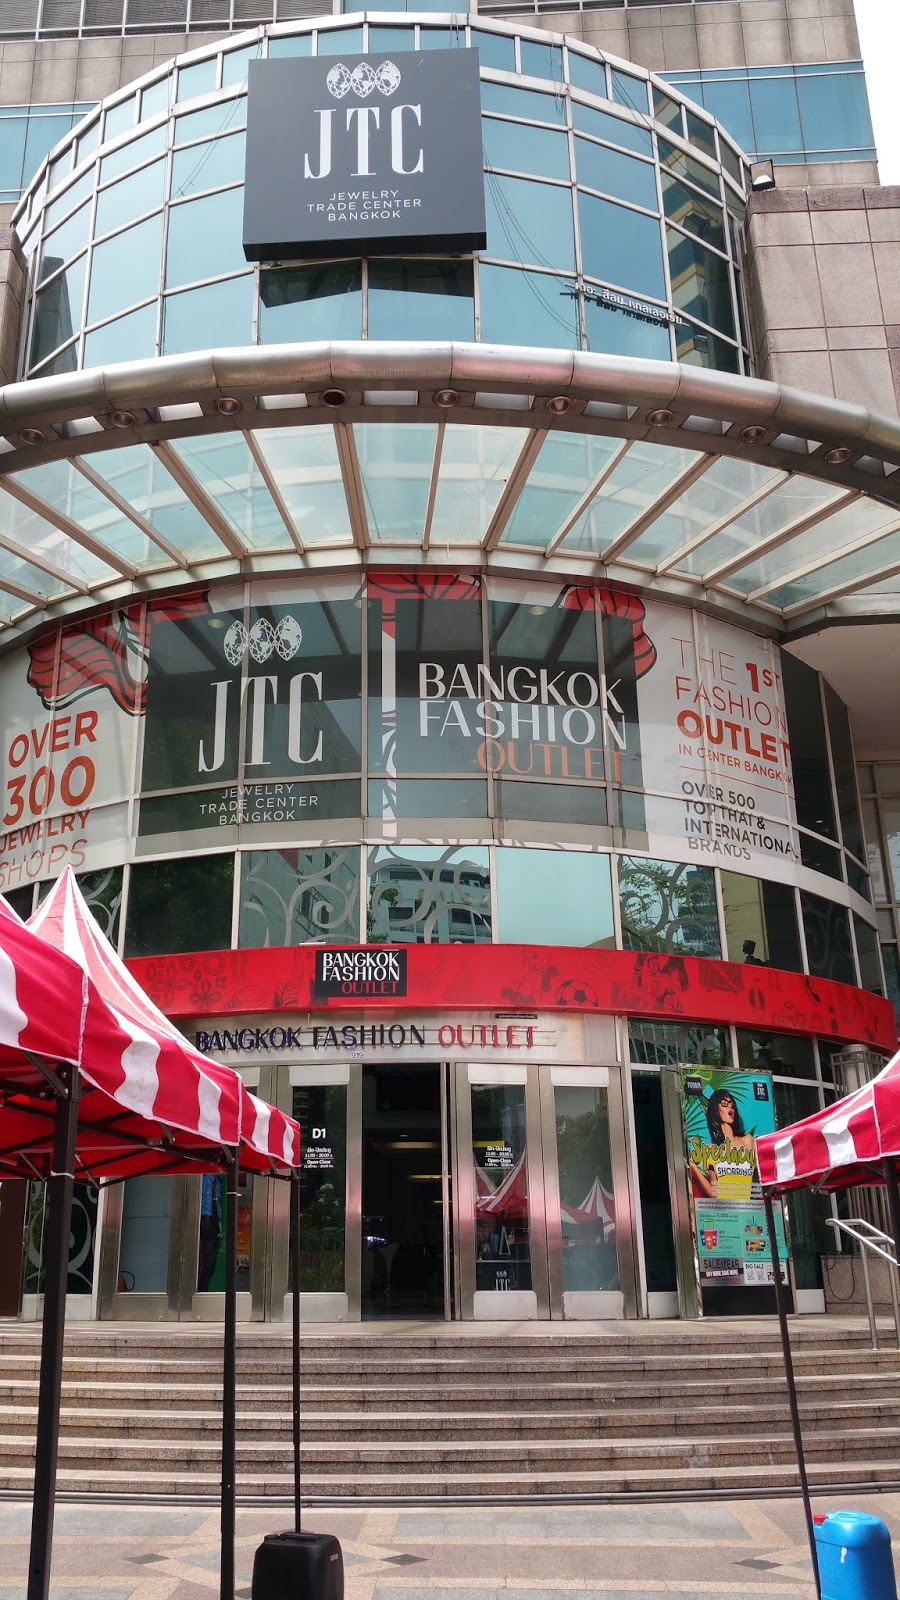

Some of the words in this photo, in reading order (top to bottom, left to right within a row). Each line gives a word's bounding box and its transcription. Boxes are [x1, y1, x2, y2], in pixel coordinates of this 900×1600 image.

[304, 104, 424, 179] JTC
[307, 201, 356, 212] TRADE
[363, 198, 422, 210] CENTER
[329, 189, 399, 201] JEWELRY
[328, 209, 401, 222] BANGKOK
[671, 637, 738, 686] THE
[745, 662, 780, 693] 1ST
[419, 662, 625, 714] BANGKOK
[675, 675, 787, 735] FASHION
[198, 671, 323, 773] JTC
[419, 700, 627, 750] FASHION
[8, 710, 99, 768] OVER
[676, 709, 791, 768] OUTLET
[477, 738, 628, 782] OUTLET
[678, 743, 692, 756] IN
[697, 747, 741, 769] CENTER
[3, 755, 96, 826] 300
[222, 783, 295, 799] JEWELRY
[681, 780, 724, 802] OVER
[728, 790, 756, 810] 500
[200, 800, 248, 815] TRADE
[255, 795, 319, 809] CENTER
[219, 809, 296, 826] BANGKOK
[684, 798, 716, 816] TOP
[720, 804, 753, 827] THAI
[756, 816, 766, 831] &
[0, 807, 91, 855] JEWELRY
[686, 836, 752, 861] BRANDS
[322, 966, 400, 981] FASHION
[323, 952, 399, 967] BANGKOK
[341, 981, 399, 994] OUTLET
[195, 1026, 303, 1053] BANGKOK
[308, 1023, 425, 1050] FASHION
[438, 1024, 538, 1049] OUTLET
[351, 1051, 364, 1059] 919
[312, 1128, 326, 1139] D1
[691, 1137, 756, 1171] Spectacu
[717, 1166, 753, 1176] SHOPPING
[703, 1259, 721, 1269] SALE
